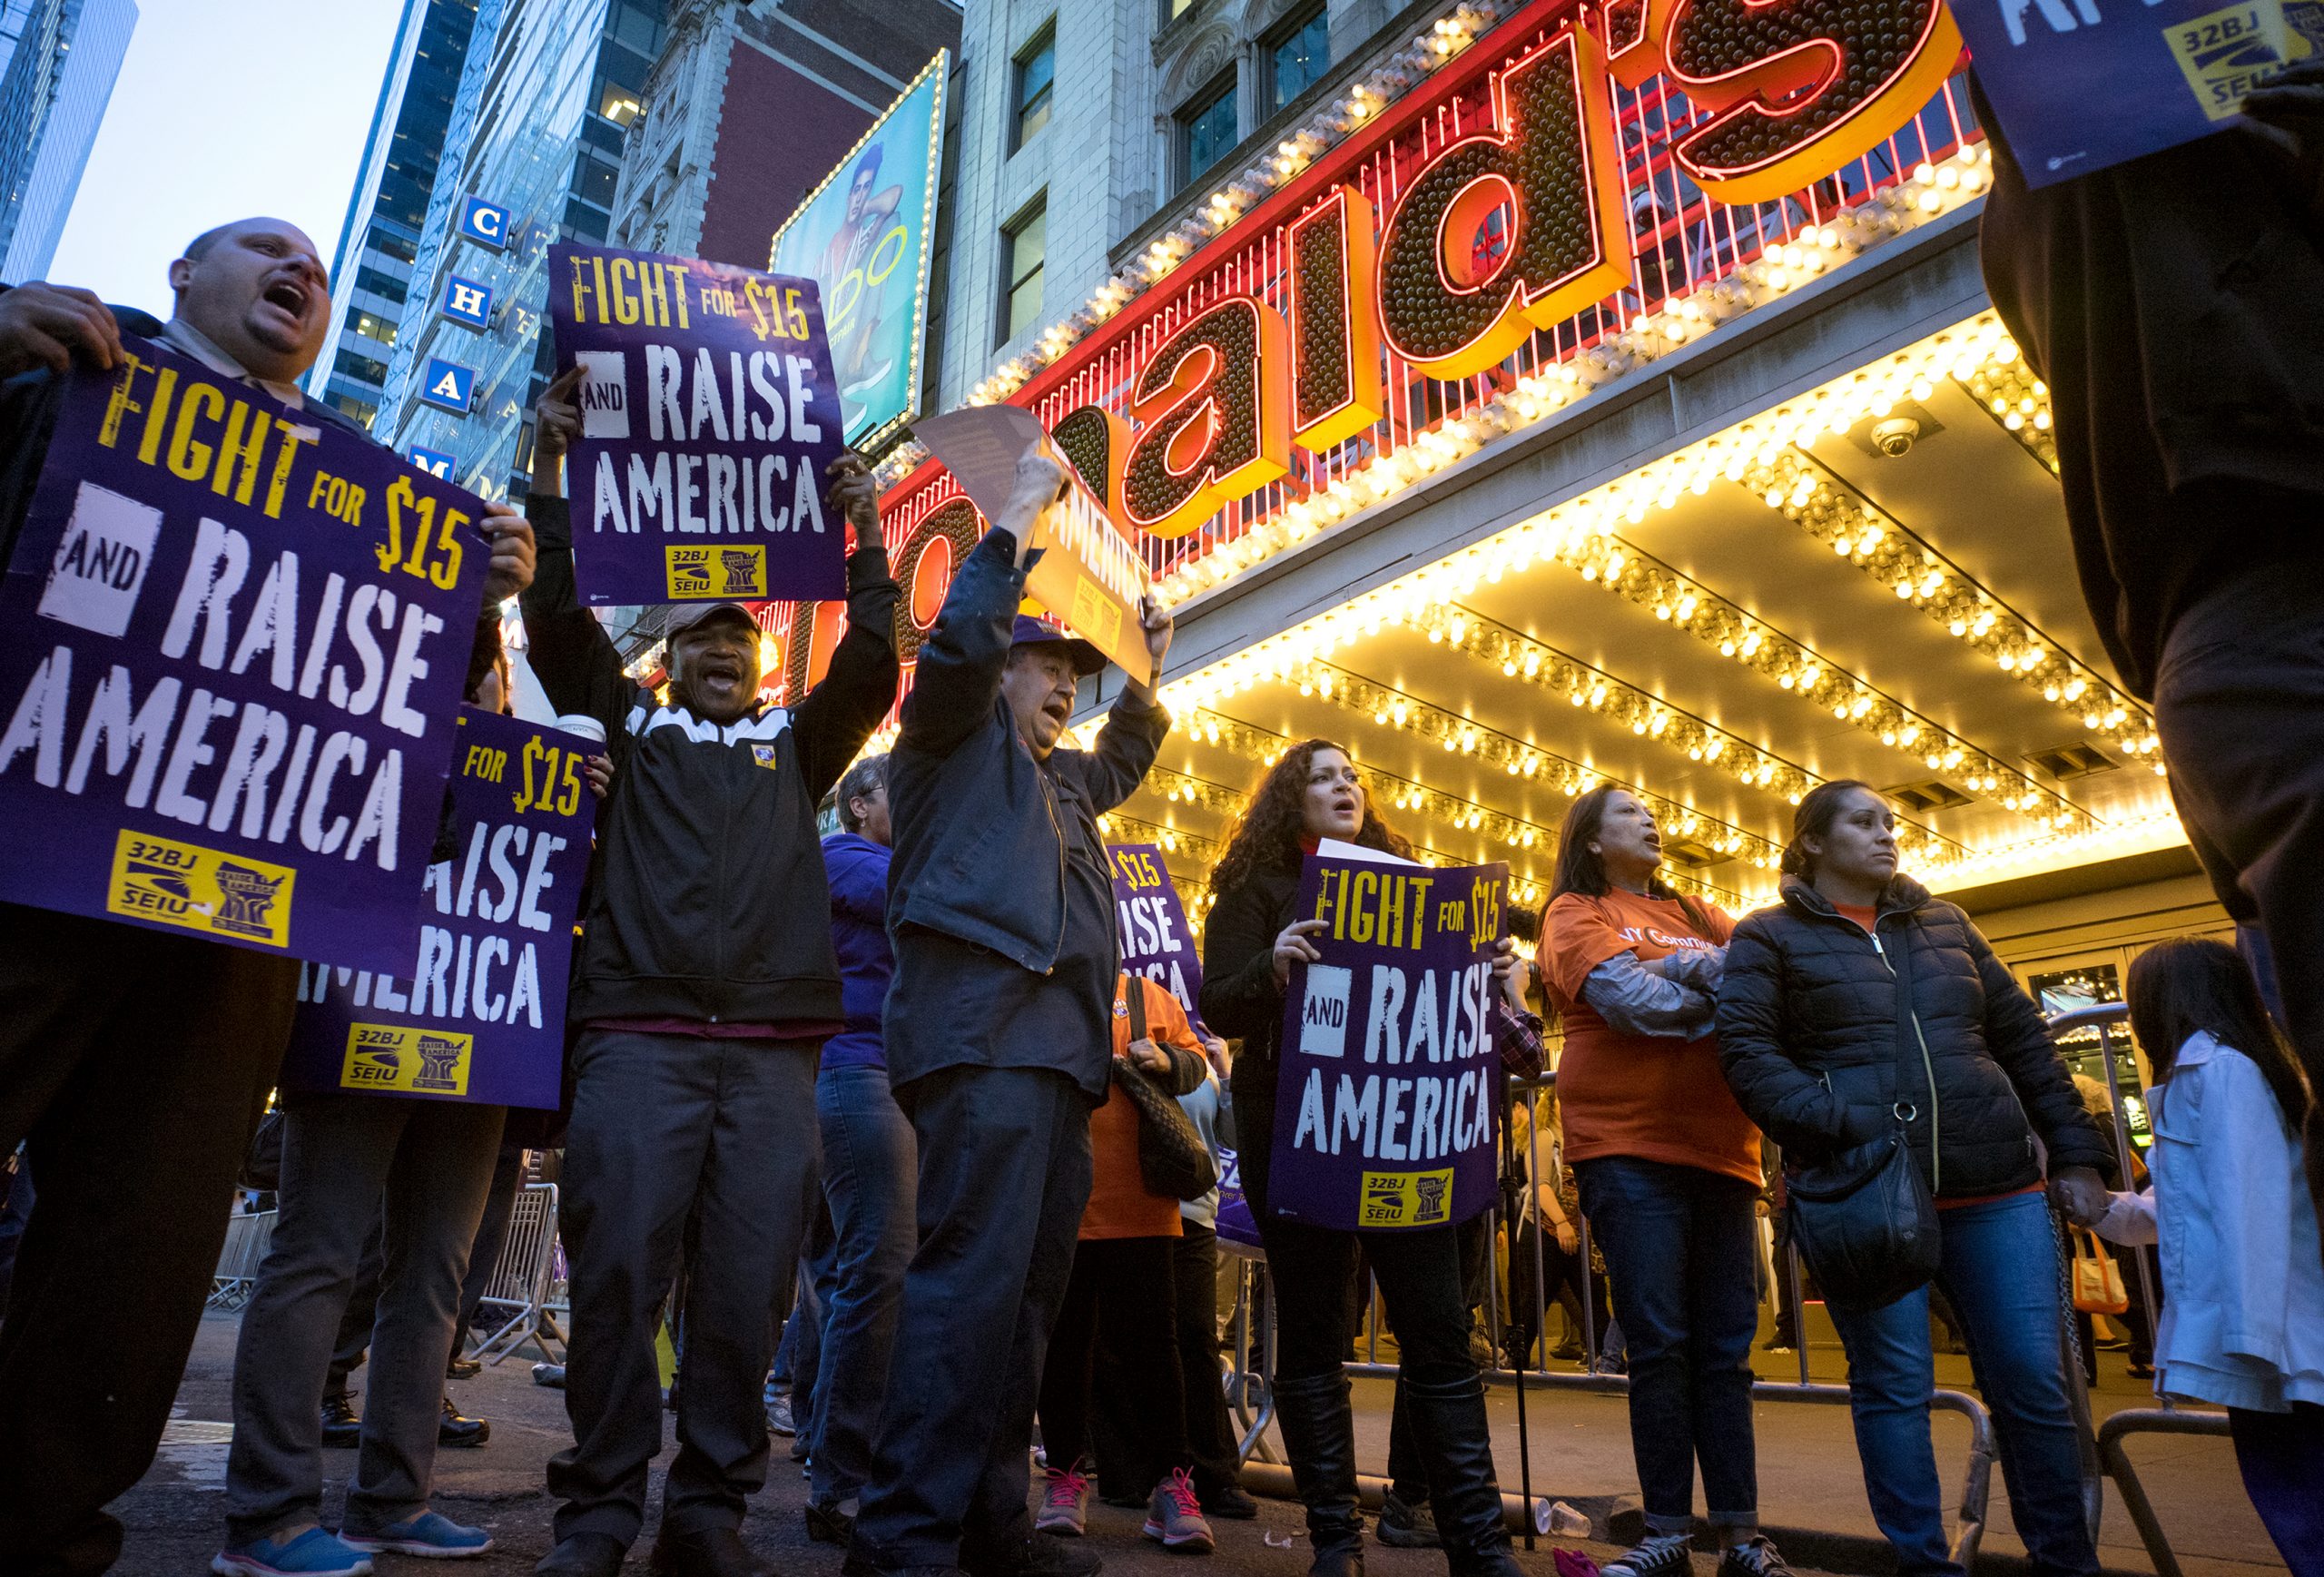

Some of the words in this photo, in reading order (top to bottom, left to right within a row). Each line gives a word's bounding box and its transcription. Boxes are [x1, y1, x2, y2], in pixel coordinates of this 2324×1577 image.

[2183, 10, 2260, 53] 32BJ
[2212, 70, 2270, 104] SEI
[569, 255, 690, 329] FIGHT
[701, 288, 737, 318] FOR
[744, 276, 810, 341] $15
[584, 382, 623, 412] AND
[645, 344, 822, 443] RAISE
[98, 352, 320, 519] FIGHT
[308, 471, 367, 527] FOR
[375, 475, 470, 590] $15
[594, 451, 824, 534] AMERICA
[672, 551, 709, 562] 32BJ
[675, 581, 710, 591] SEIU
[61, 529, 141, 590] AND
[162, 517, 443, 738] RAISE
[0, 646, 402, 872] AMERICA
[463, 744, 507, 784] FOR
[513, 735, 583, 817] $15
[128, 842, 198, 870] 32BJ
[1118, 850, 1161, 892] $15
[122, 890, 190, 914] SEIU
[1119, 897, 1182, 960] ISE
[1313, 868, 1433, 951] FIGHT
[1437, 902, 1465, 932] FOR
[1470, 876, 1501, 953] $15
[356, 1030, 405, 1045] 32BJ
[1306, 994, 1344, 1028] AND
[1364, 962, 1492, 1064] RAISE
[350, 1067, 399, 1080] SEIU
[1294, 1066, 1490, 1161] AMERICA
[1368, 1178, 1406, 1189] 32BJ
[1365, 1208, 1403, 1219] SEIU
